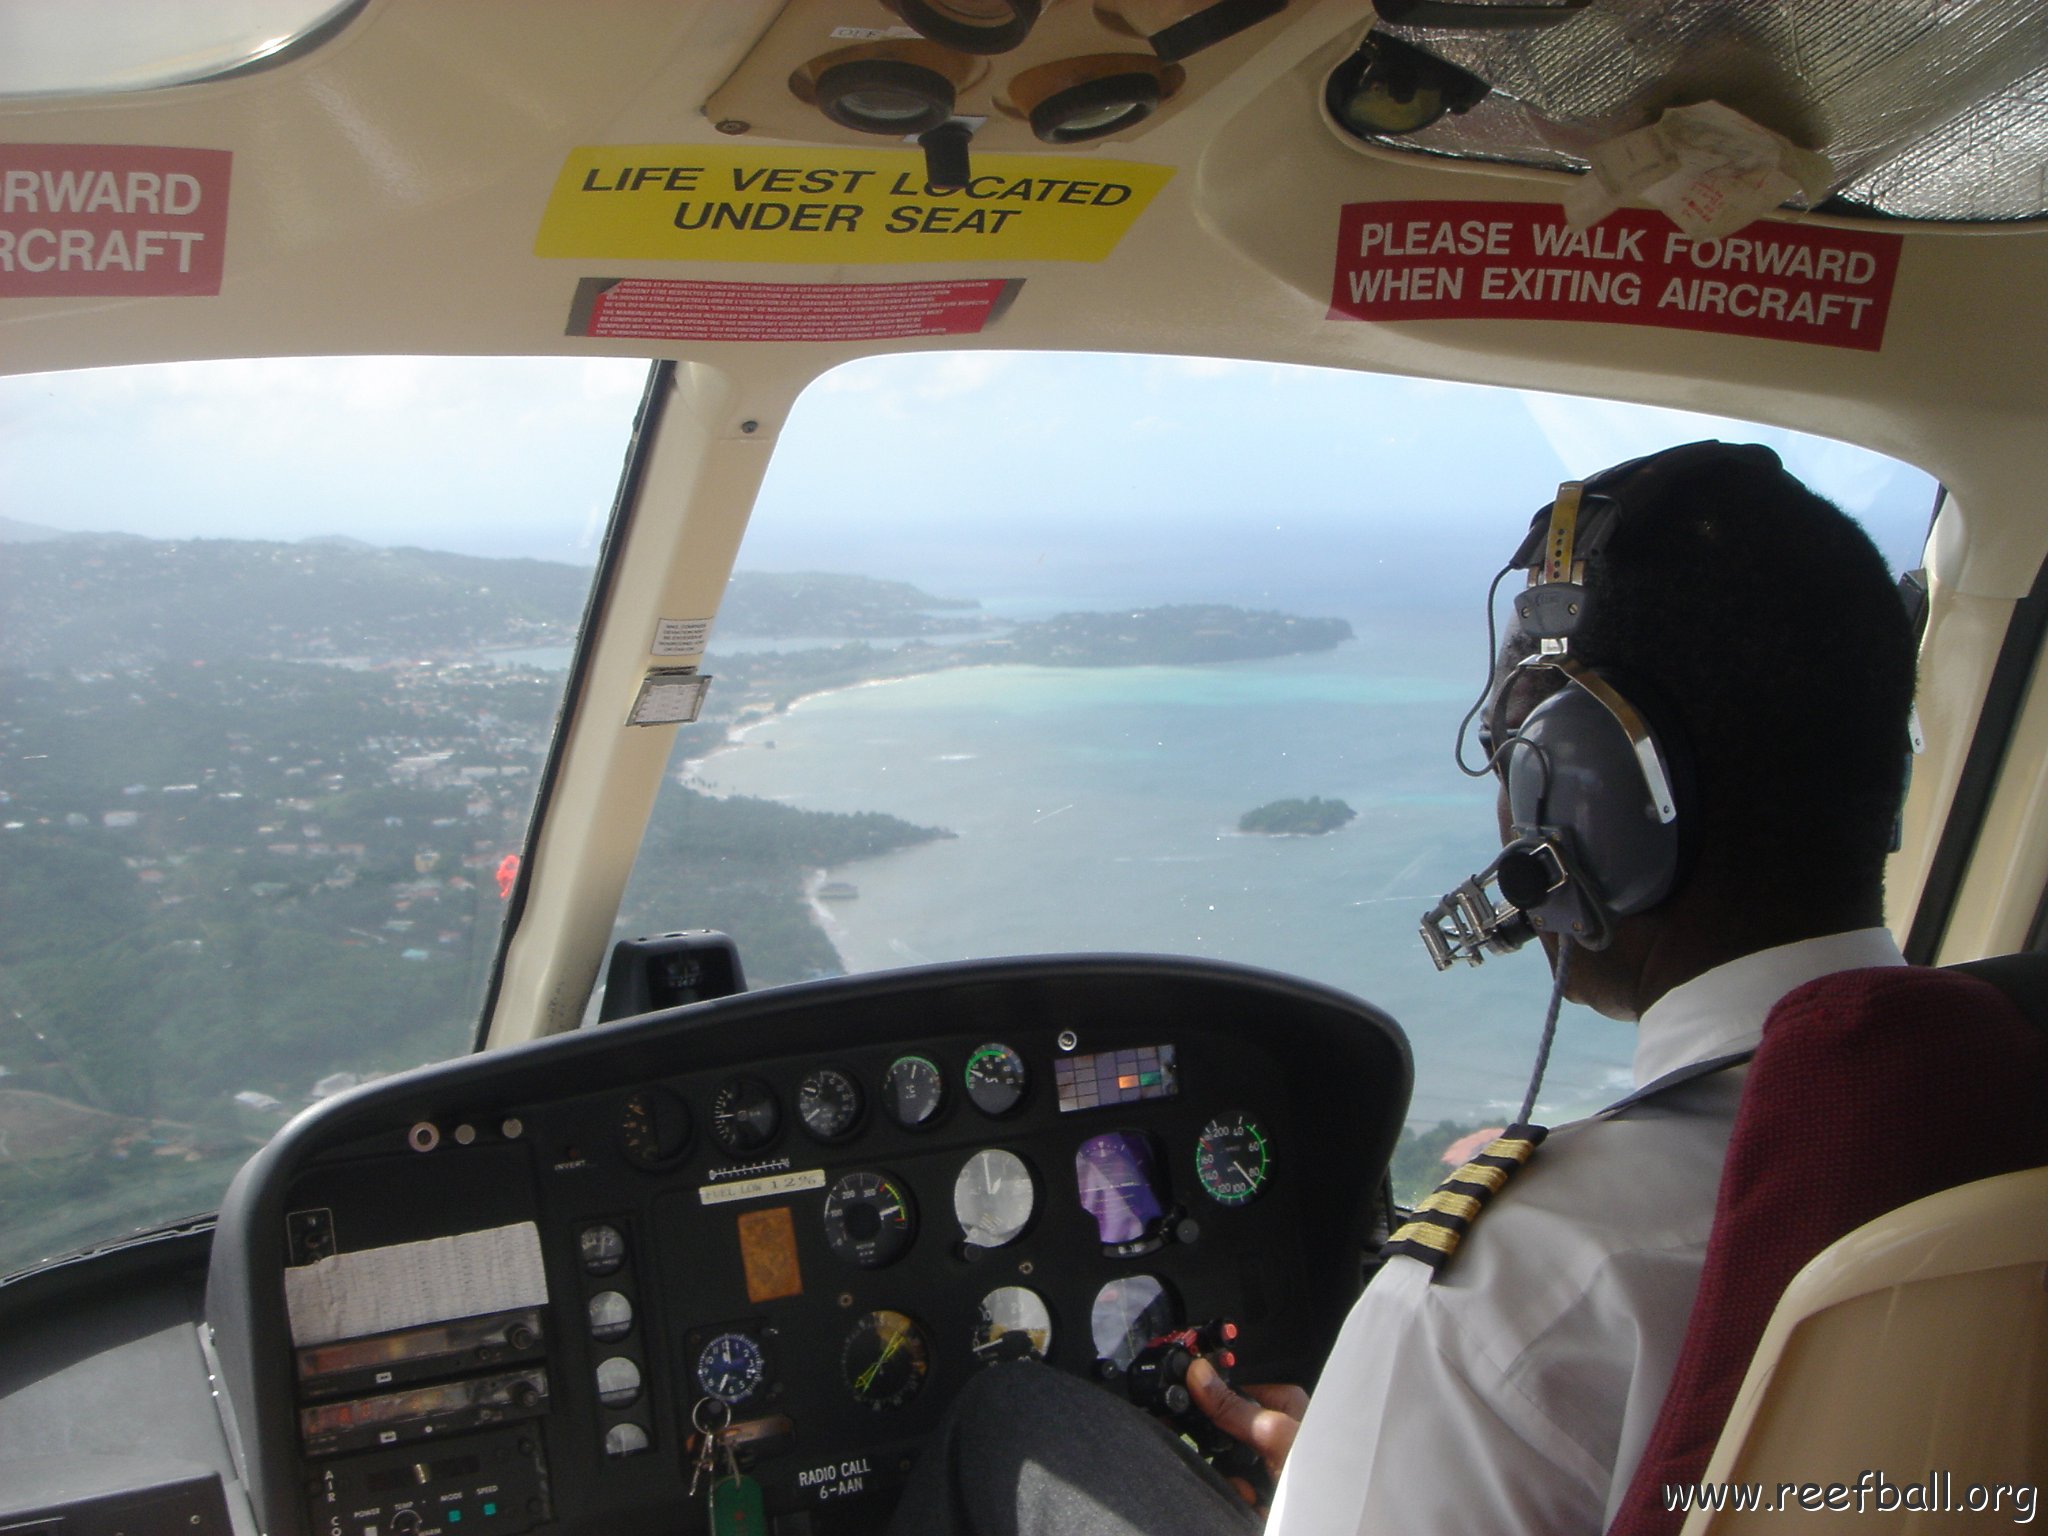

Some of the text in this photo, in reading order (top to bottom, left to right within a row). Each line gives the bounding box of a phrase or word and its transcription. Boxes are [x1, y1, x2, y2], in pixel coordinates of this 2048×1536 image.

[581, 166, 706, 192] LIFE
[732, 168, 876, 195] VEST
[0, 171, 202, 215] RWARD
[672, 200, 1022, 235] UNDER SEAT
[1360, 221, 1876, 284] PLEASE WALK FORWARD
[1348, 267, 1873, 330] WHEN EXITING AIRCRAFT
[1213, 1126, 1229, 1137] 200
[1233, 1126, 1244, 1136] 40
[1248, 1141, 1259, 1152] 60
[1249, 1166, 1260, 1177] 80
[842, 1189, 856, 1200] 200
[1232, 1182, 1246, 1193] 100
[738, 1380, 746, 1389] 5
[798, 1458, 872, 1487] RADIO CALL
[819, 1477, 864, 1499] 6-AAN
[354, 1507, 380, 1518] POWER
